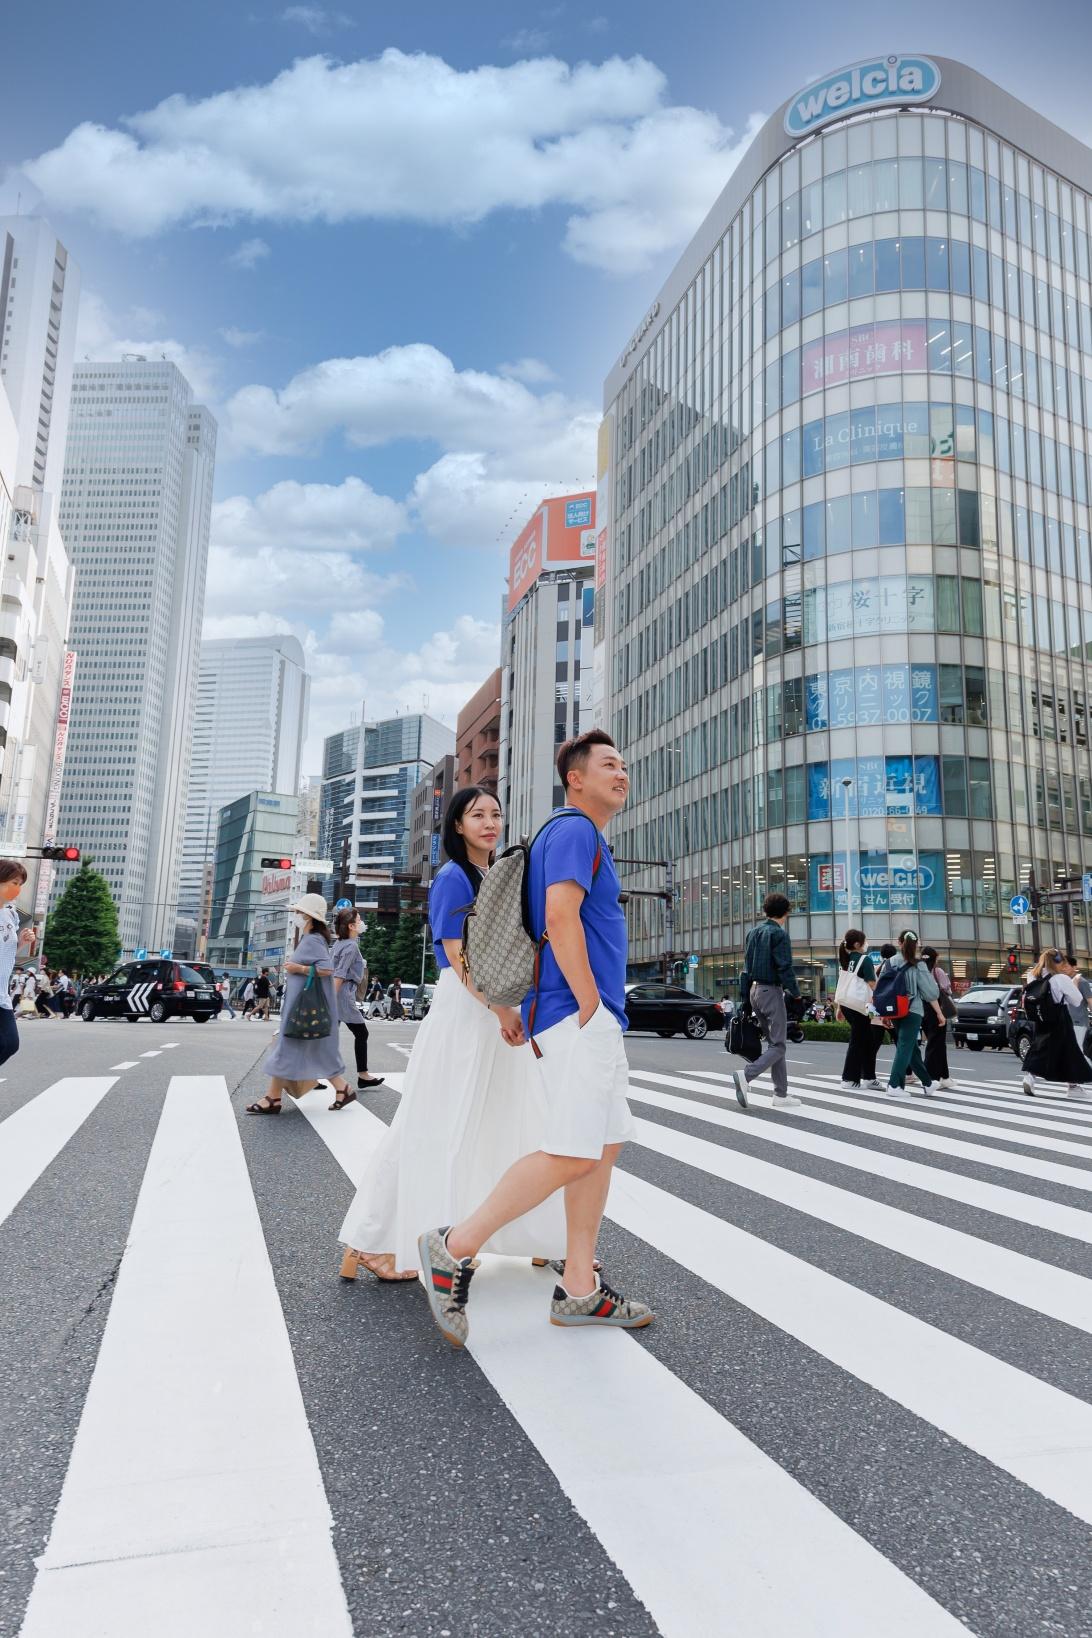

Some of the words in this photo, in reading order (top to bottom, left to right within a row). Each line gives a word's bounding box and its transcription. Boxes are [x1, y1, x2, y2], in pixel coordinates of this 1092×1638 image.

[798, 56, 923, 122] welcia
[814, 437, 833, 452] La
[838, 421, 918, 442] Clinique
[810, 671, 931, 699] 東京内視鏡
[861, 861, 924, 886] welcia
